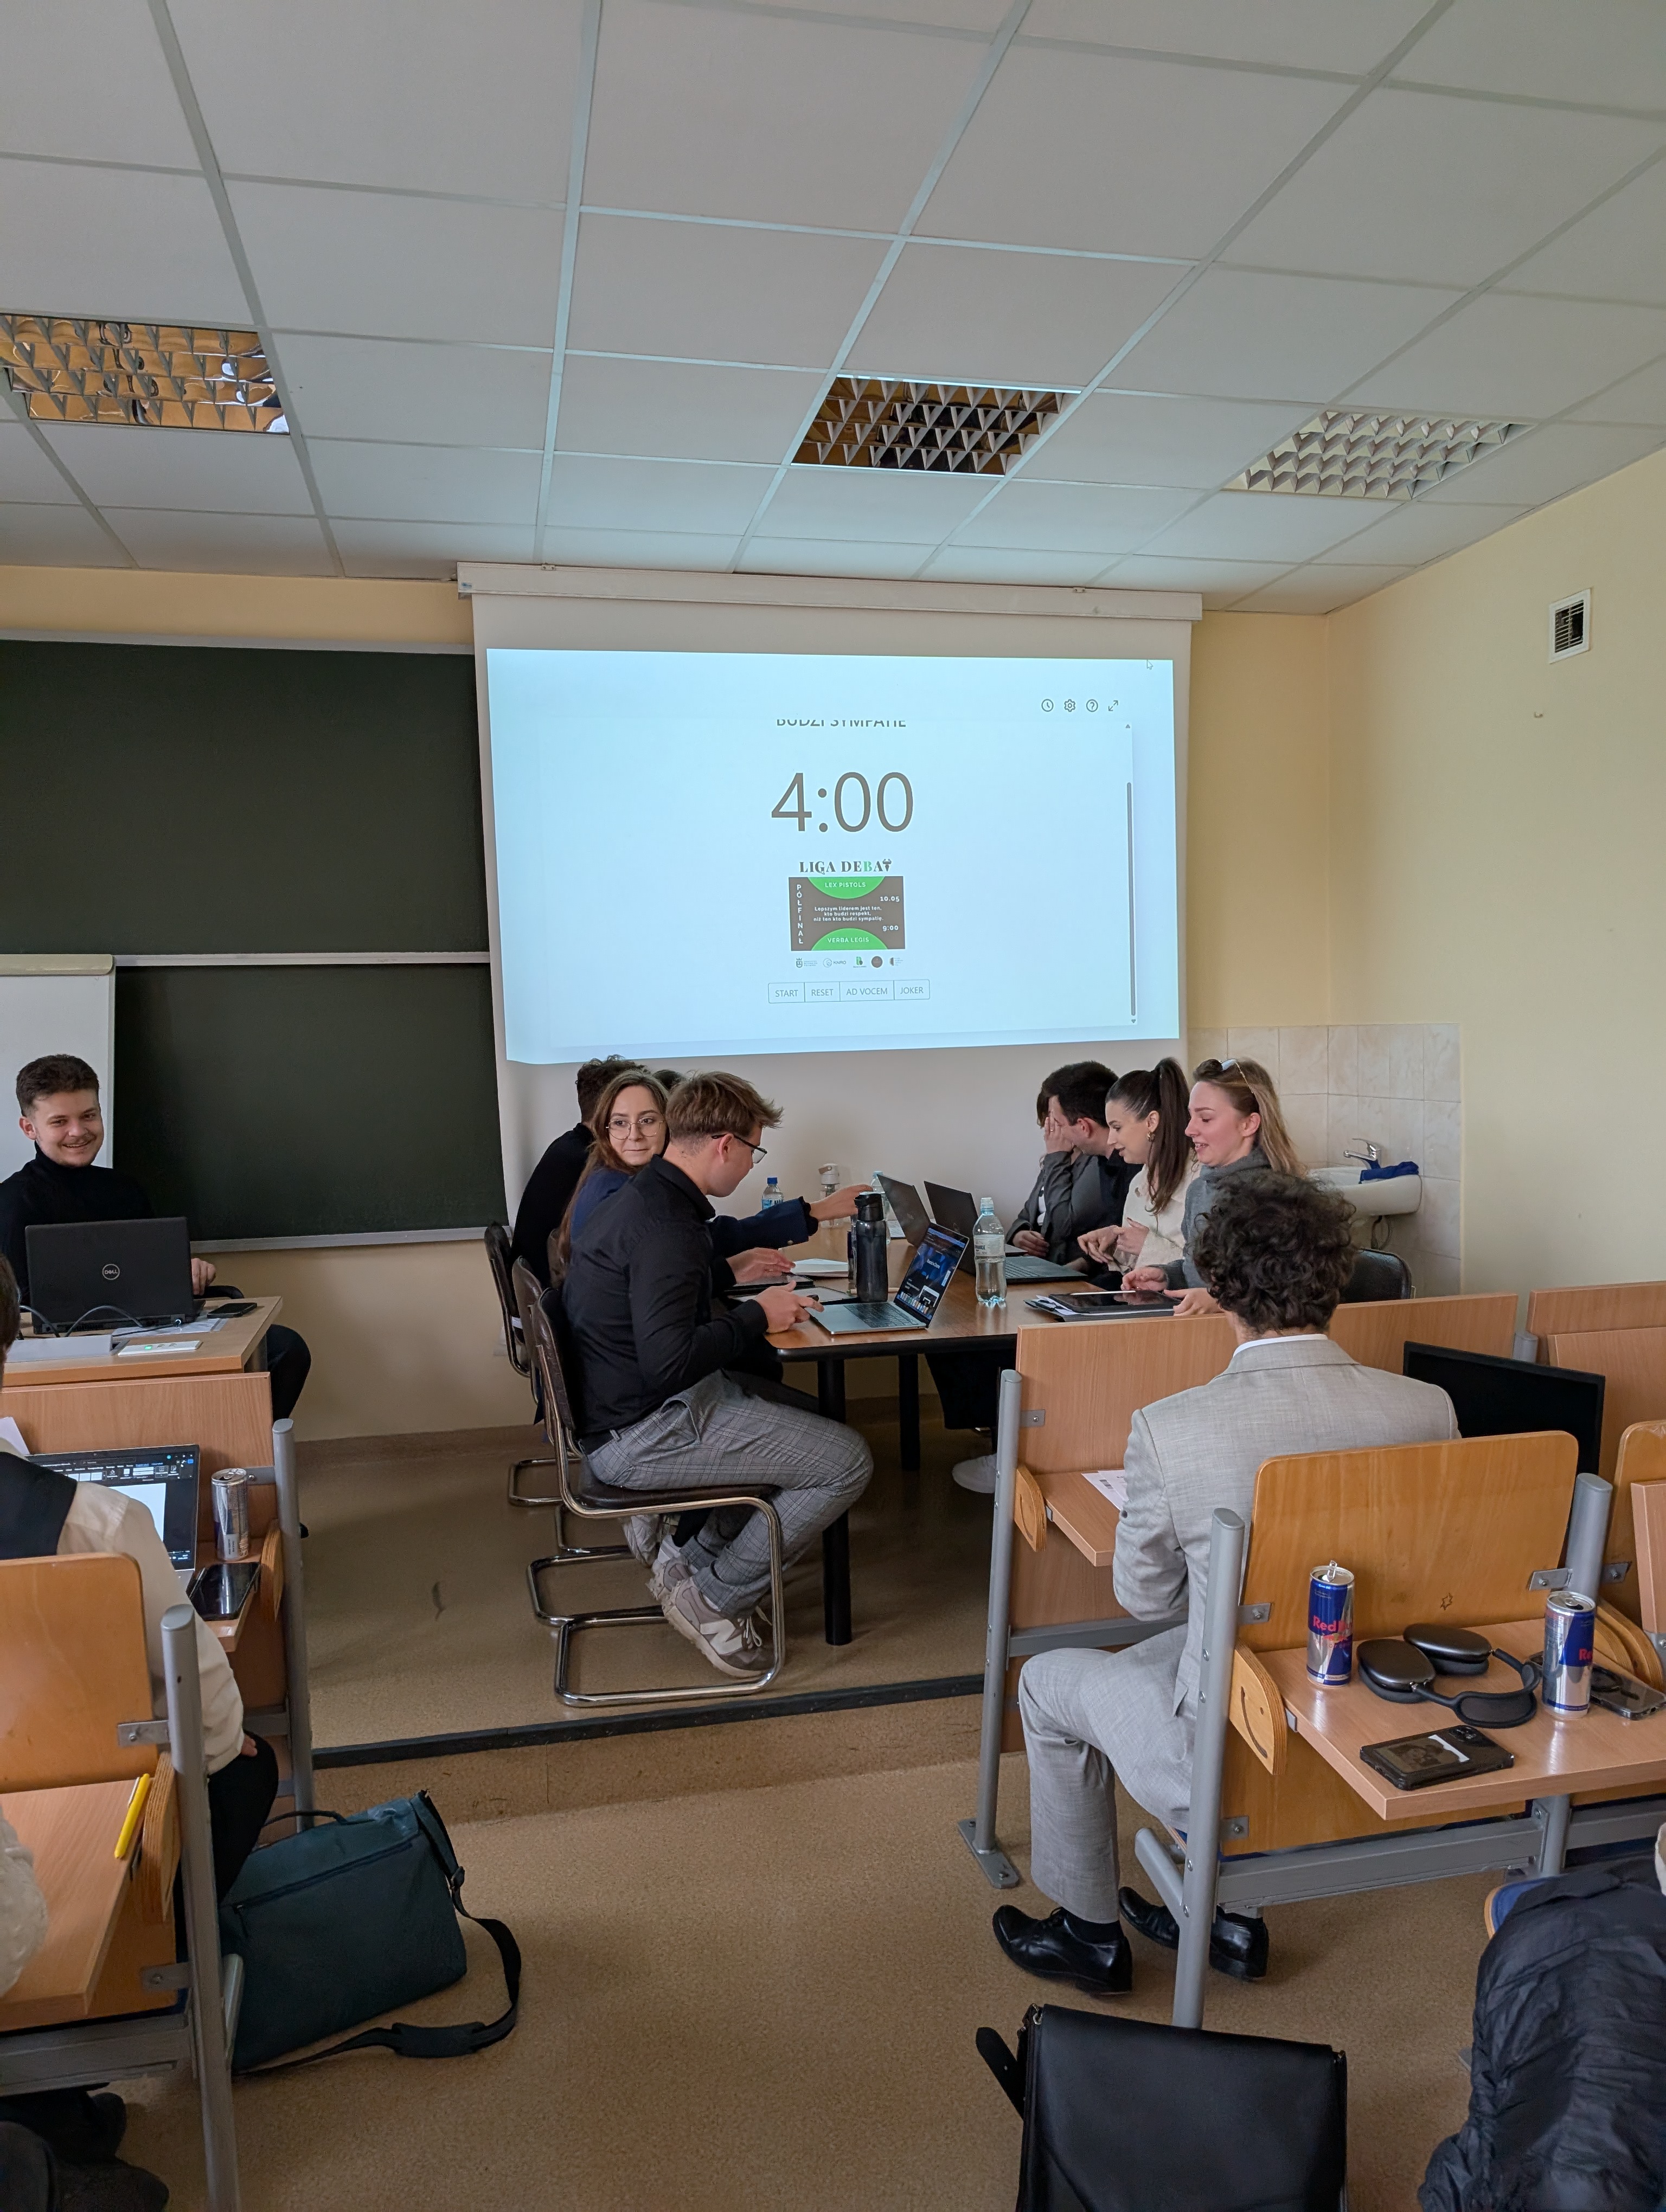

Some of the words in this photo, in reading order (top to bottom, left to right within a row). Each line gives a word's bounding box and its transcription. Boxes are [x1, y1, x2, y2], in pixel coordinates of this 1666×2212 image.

[771, 771, 913, 833] 4:00
[799, 861, 836, 874] LIGA
[1313, 1615, 1337, 1632] Red
